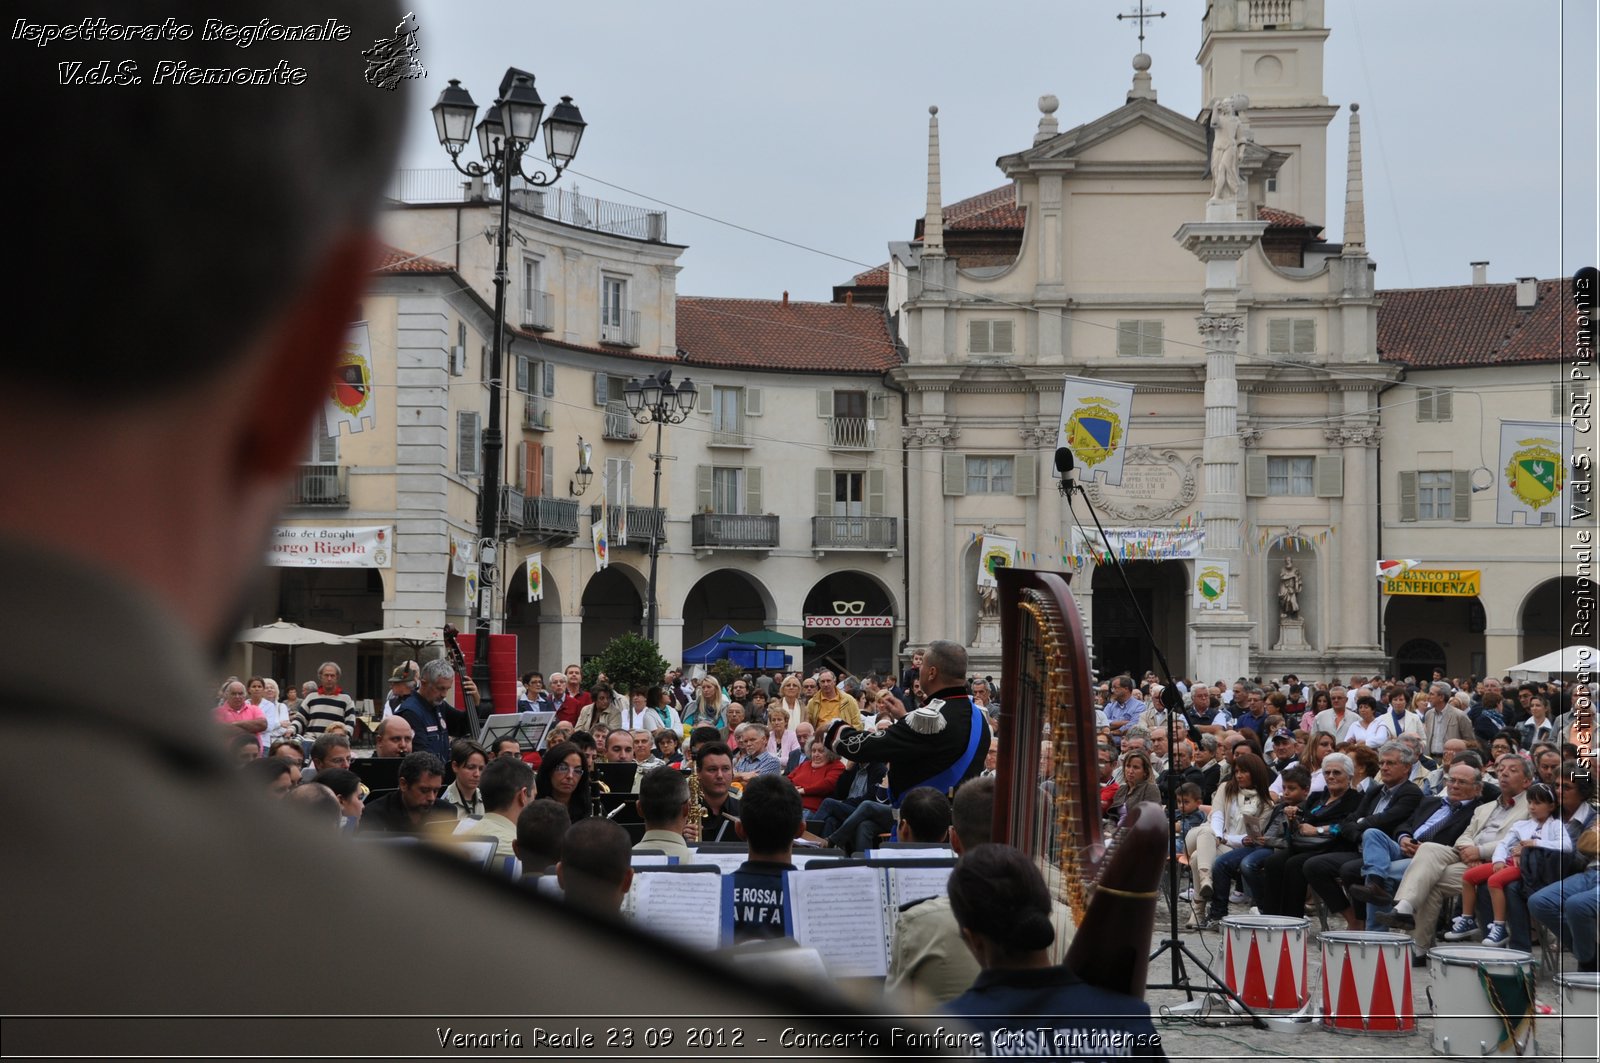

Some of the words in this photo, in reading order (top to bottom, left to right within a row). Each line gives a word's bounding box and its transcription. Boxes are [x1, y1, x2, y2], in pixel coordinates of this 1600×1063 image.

[300, 530, 316, 539] dei
[320, 530, 355, 540] Borghi
[272, 543, 309, 556] orgo
[314, 541, 366, 556] Rigola
[1403, 571, 1443, 581] BANCO
[1448, 572, 1461, 581] DI
[1387, 580, 1476, 594] BENEFICENZA
[807, 617, 841, 627] FOTO
[845, 617, 892, 627] OTTICA
[742, 888, 777, 905] ROSSA
[734, 906, 781, 924] ANFA
